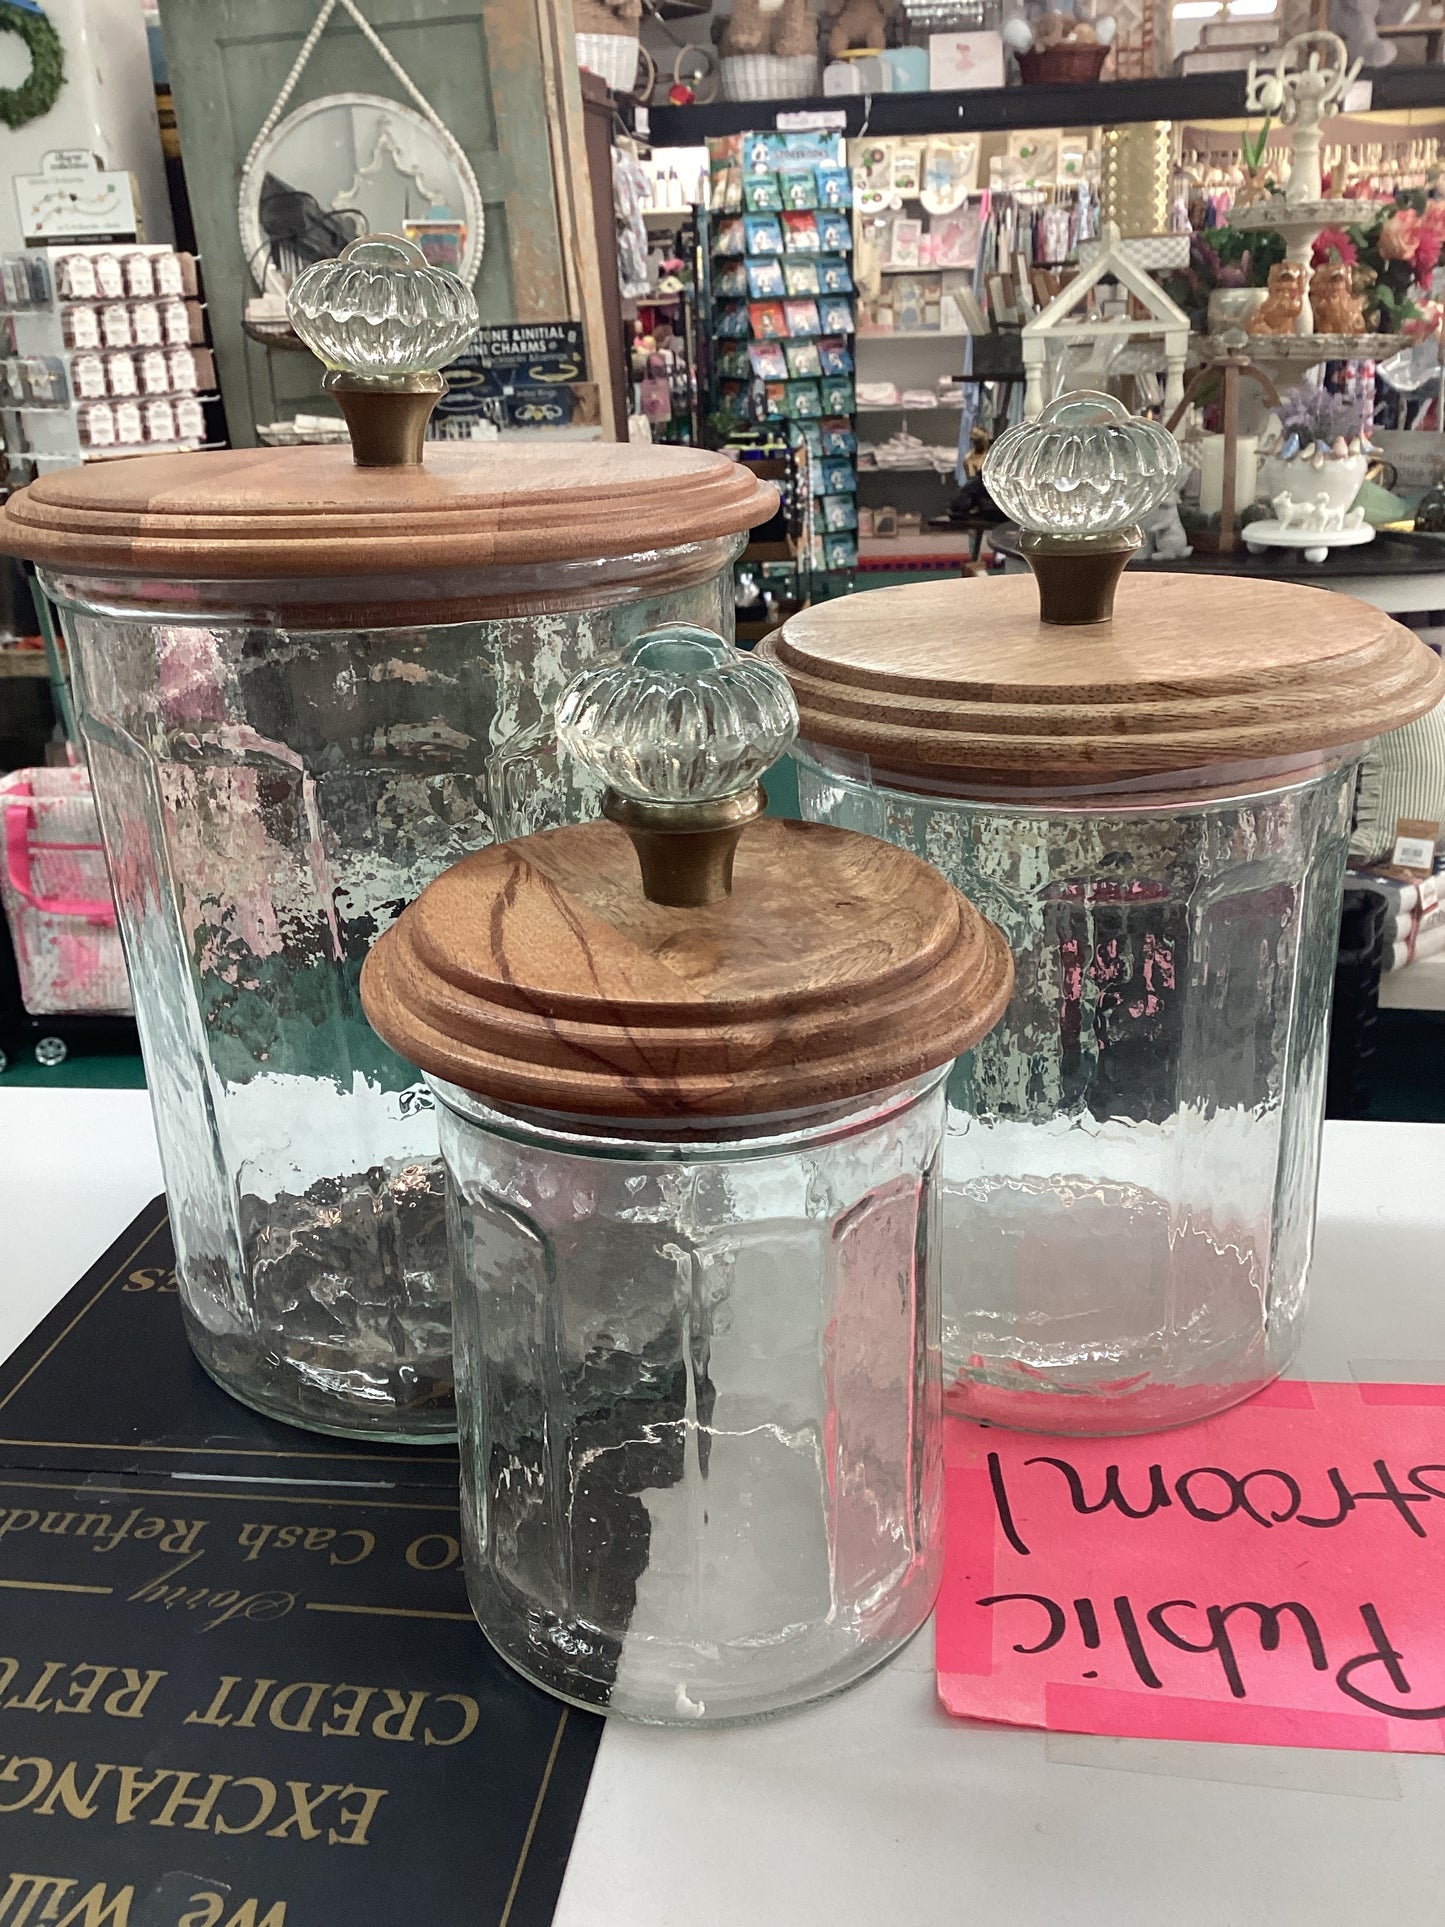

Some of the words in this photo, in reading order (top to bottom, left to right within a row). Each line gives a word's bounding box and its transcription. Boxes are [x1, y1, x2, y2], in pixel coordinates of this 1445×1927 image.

[491, 340, 547, 355] CHARMS
[0, 1507, 210, 1554] Refund
[238, 1522, 376, 1566] Cash
[405, 1534, 466, 1572] O
[127, 1549, 301, 1633] Sorry
[976, 1594, 1445, 1720] Public
[183, 1676, 480, 1746] CREDIT
[0, 1754, 389, 1846] EXCHANG
